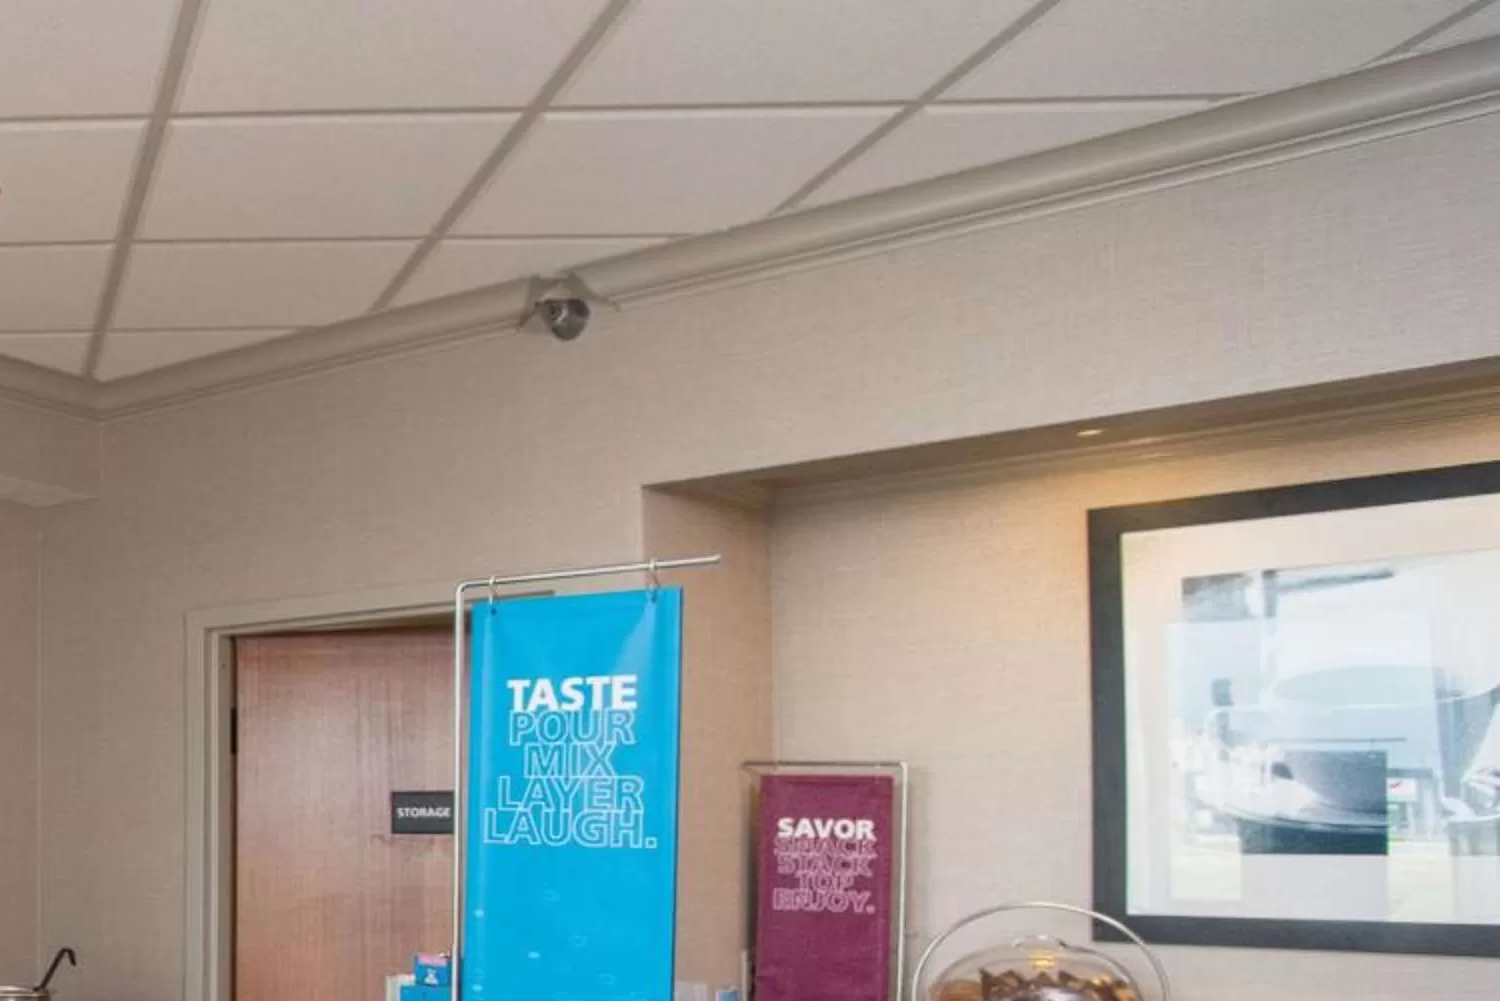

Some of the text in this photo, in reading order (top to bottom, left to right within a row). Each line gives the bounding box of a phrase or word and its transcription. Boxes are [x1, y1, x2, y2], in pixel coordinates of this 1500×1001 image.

[507, 674, 638, 713] TASTE
[509, 708, 637, 746] POUR
[523, 740, 618, 778] MIX
[498, 775, 645, 814] LAYER
[396, 807, 451, 818] STORAGE
[484, 807, 658, 849] LAUGH.
[777, 817, 877, 842] SAVOR
[777, 852, 874, 878] STACK
[795, 870, 855, 894] TOP
[772, 887, 876, 914] ENJOY.
